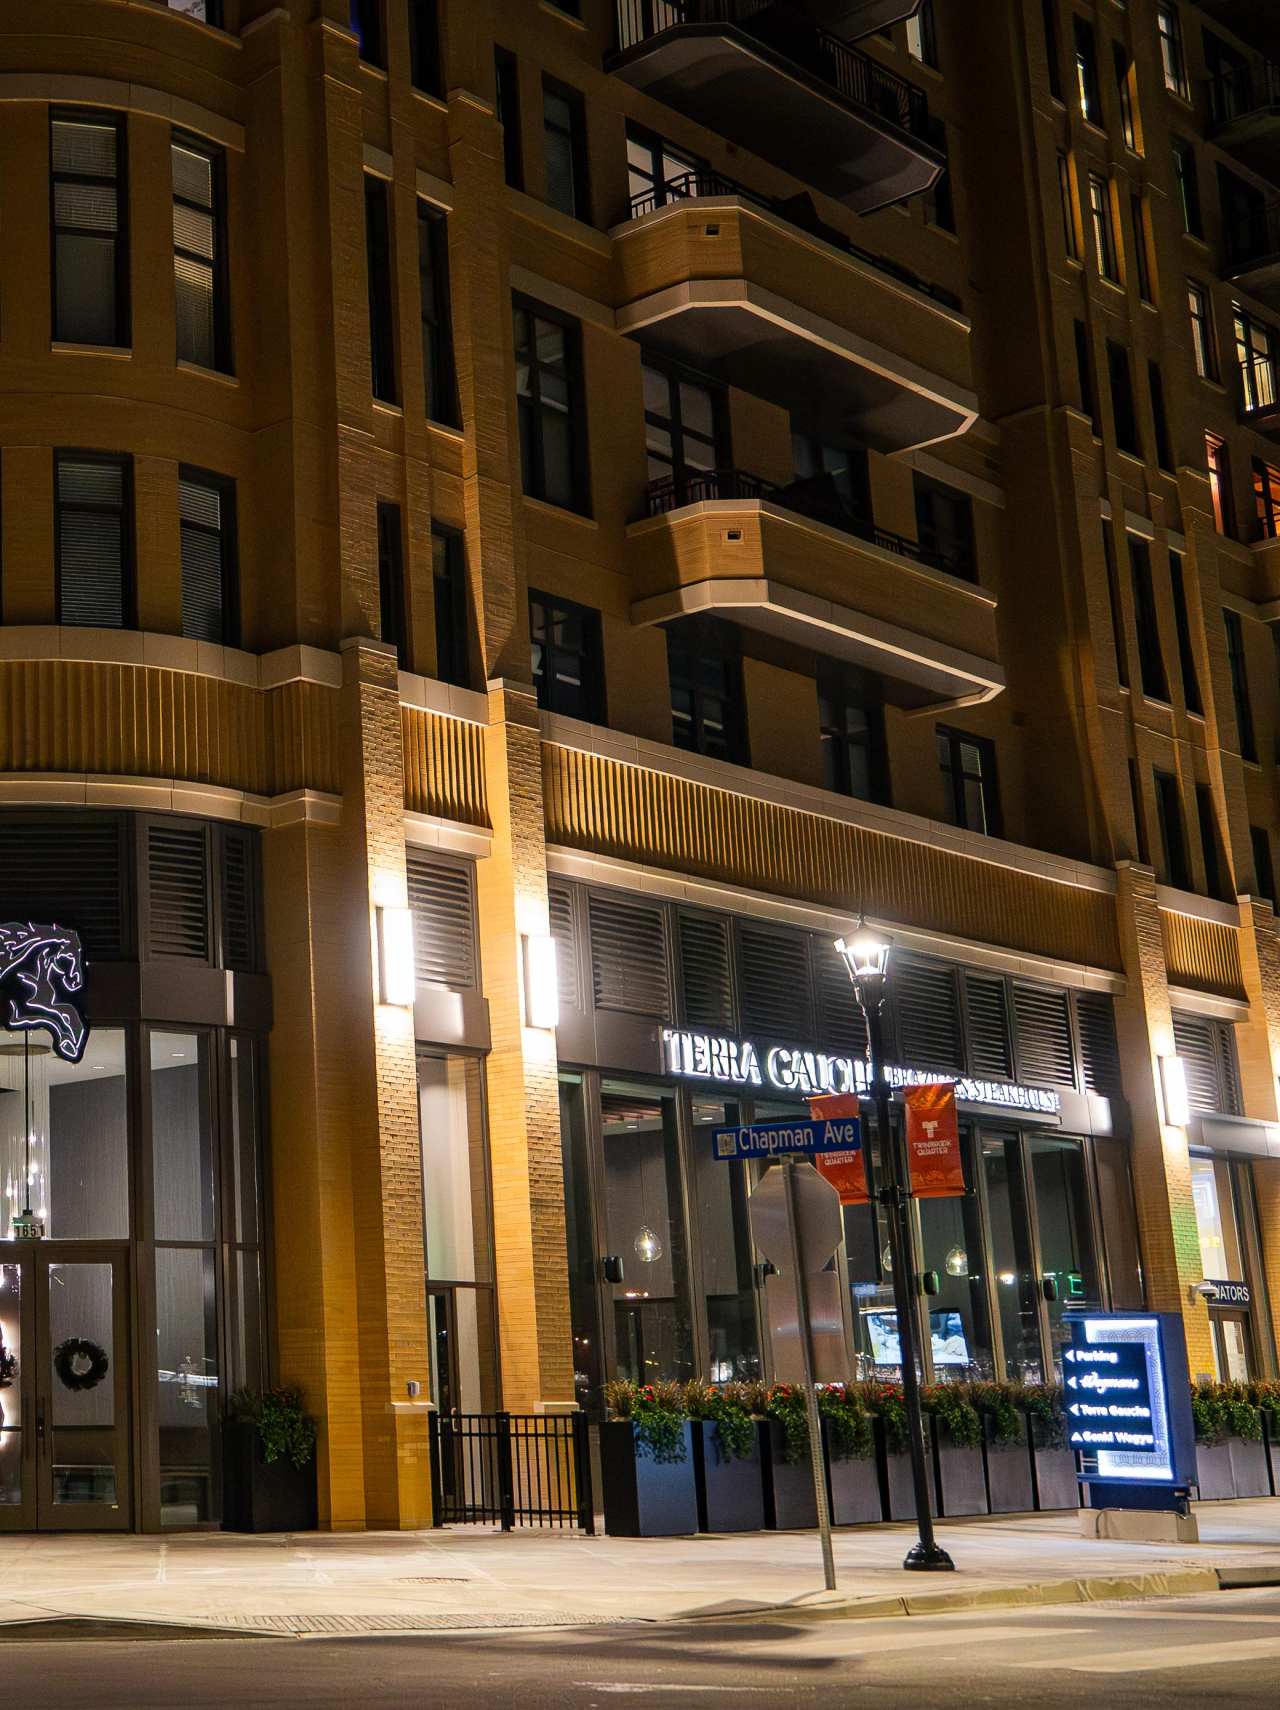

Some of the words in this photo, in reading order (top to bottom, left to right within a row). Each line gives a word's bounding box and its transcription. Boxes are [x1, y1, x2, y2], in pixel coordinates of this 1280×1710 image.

[664, 1030, 762, 1084] TERRA
[768, 1047, 894, 1101] GAUCH
[969, 1079, 1061, 1113] STEAKHOUSE
[738, 1127, 814, 1154] Chapman
[824, 1121, 854, 1145] Ave
[917, 1147, 948, 1156] QUARTER
[824, 1156, 853, 1166] QUARTER
[15, 1223, 45, 1237] 1651
[1076, 1350, 1118, 1364] Parking
[1080, 1404, 1108, 1416] Terra
[1109, 1405, 1151, 1417] Gaucha
[1114, 1432, 1154, 1446] Wagyu
